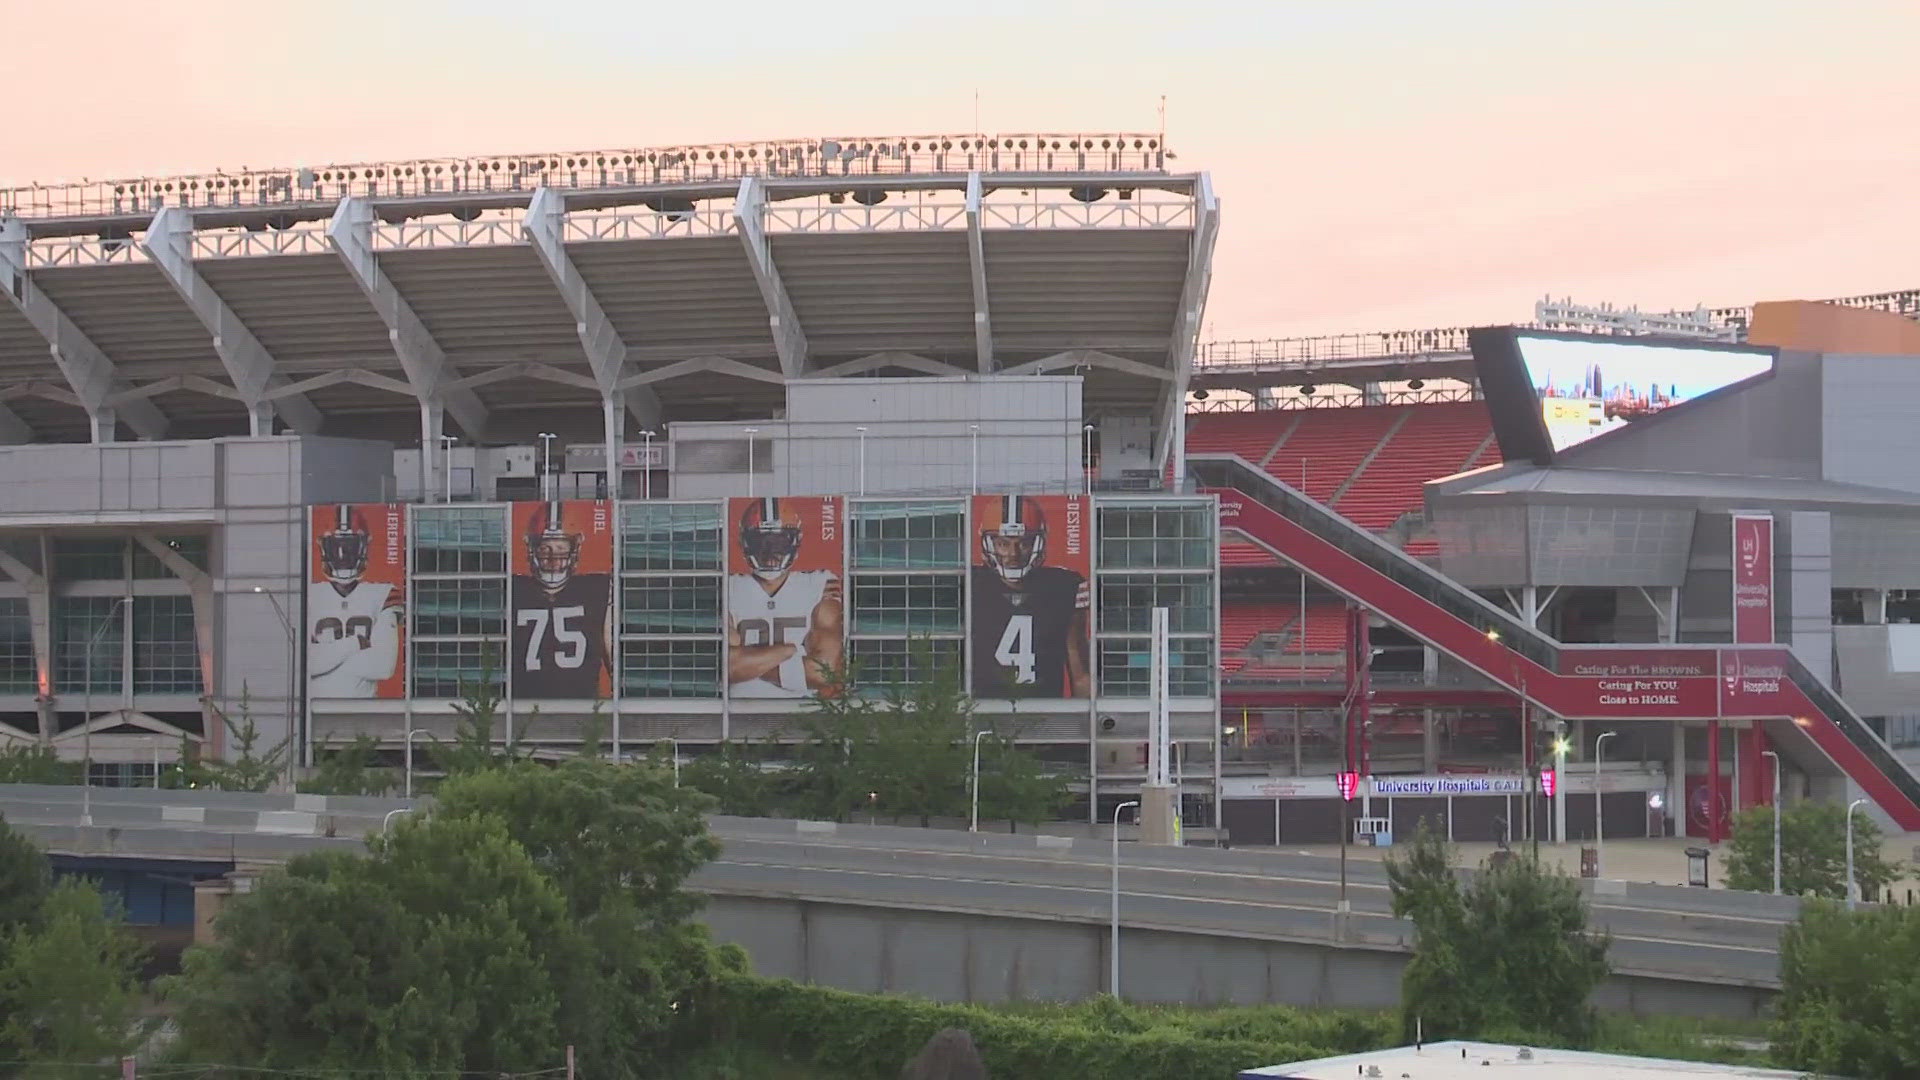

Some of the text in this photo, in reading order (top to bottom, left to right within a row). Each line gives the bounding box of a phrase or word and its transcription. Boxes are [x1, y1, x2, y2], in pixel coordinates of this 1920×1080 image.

[593, 508, 606, 535] JOEL
[1066, 502, 1080, 555] DESHAUN
[516, 605, 587, 671] 75
[994, 614, 1036, 685] 4
[1598, 680, 1633, 692] Caring
[1634, 681, 1652, 690] For
[1599, 695, 1628, 704] Close
[1628, 695, 1640, 704] to
[1376, 779, 1435, 794] University
[1437, 778, 1490, 793] Hospitals
